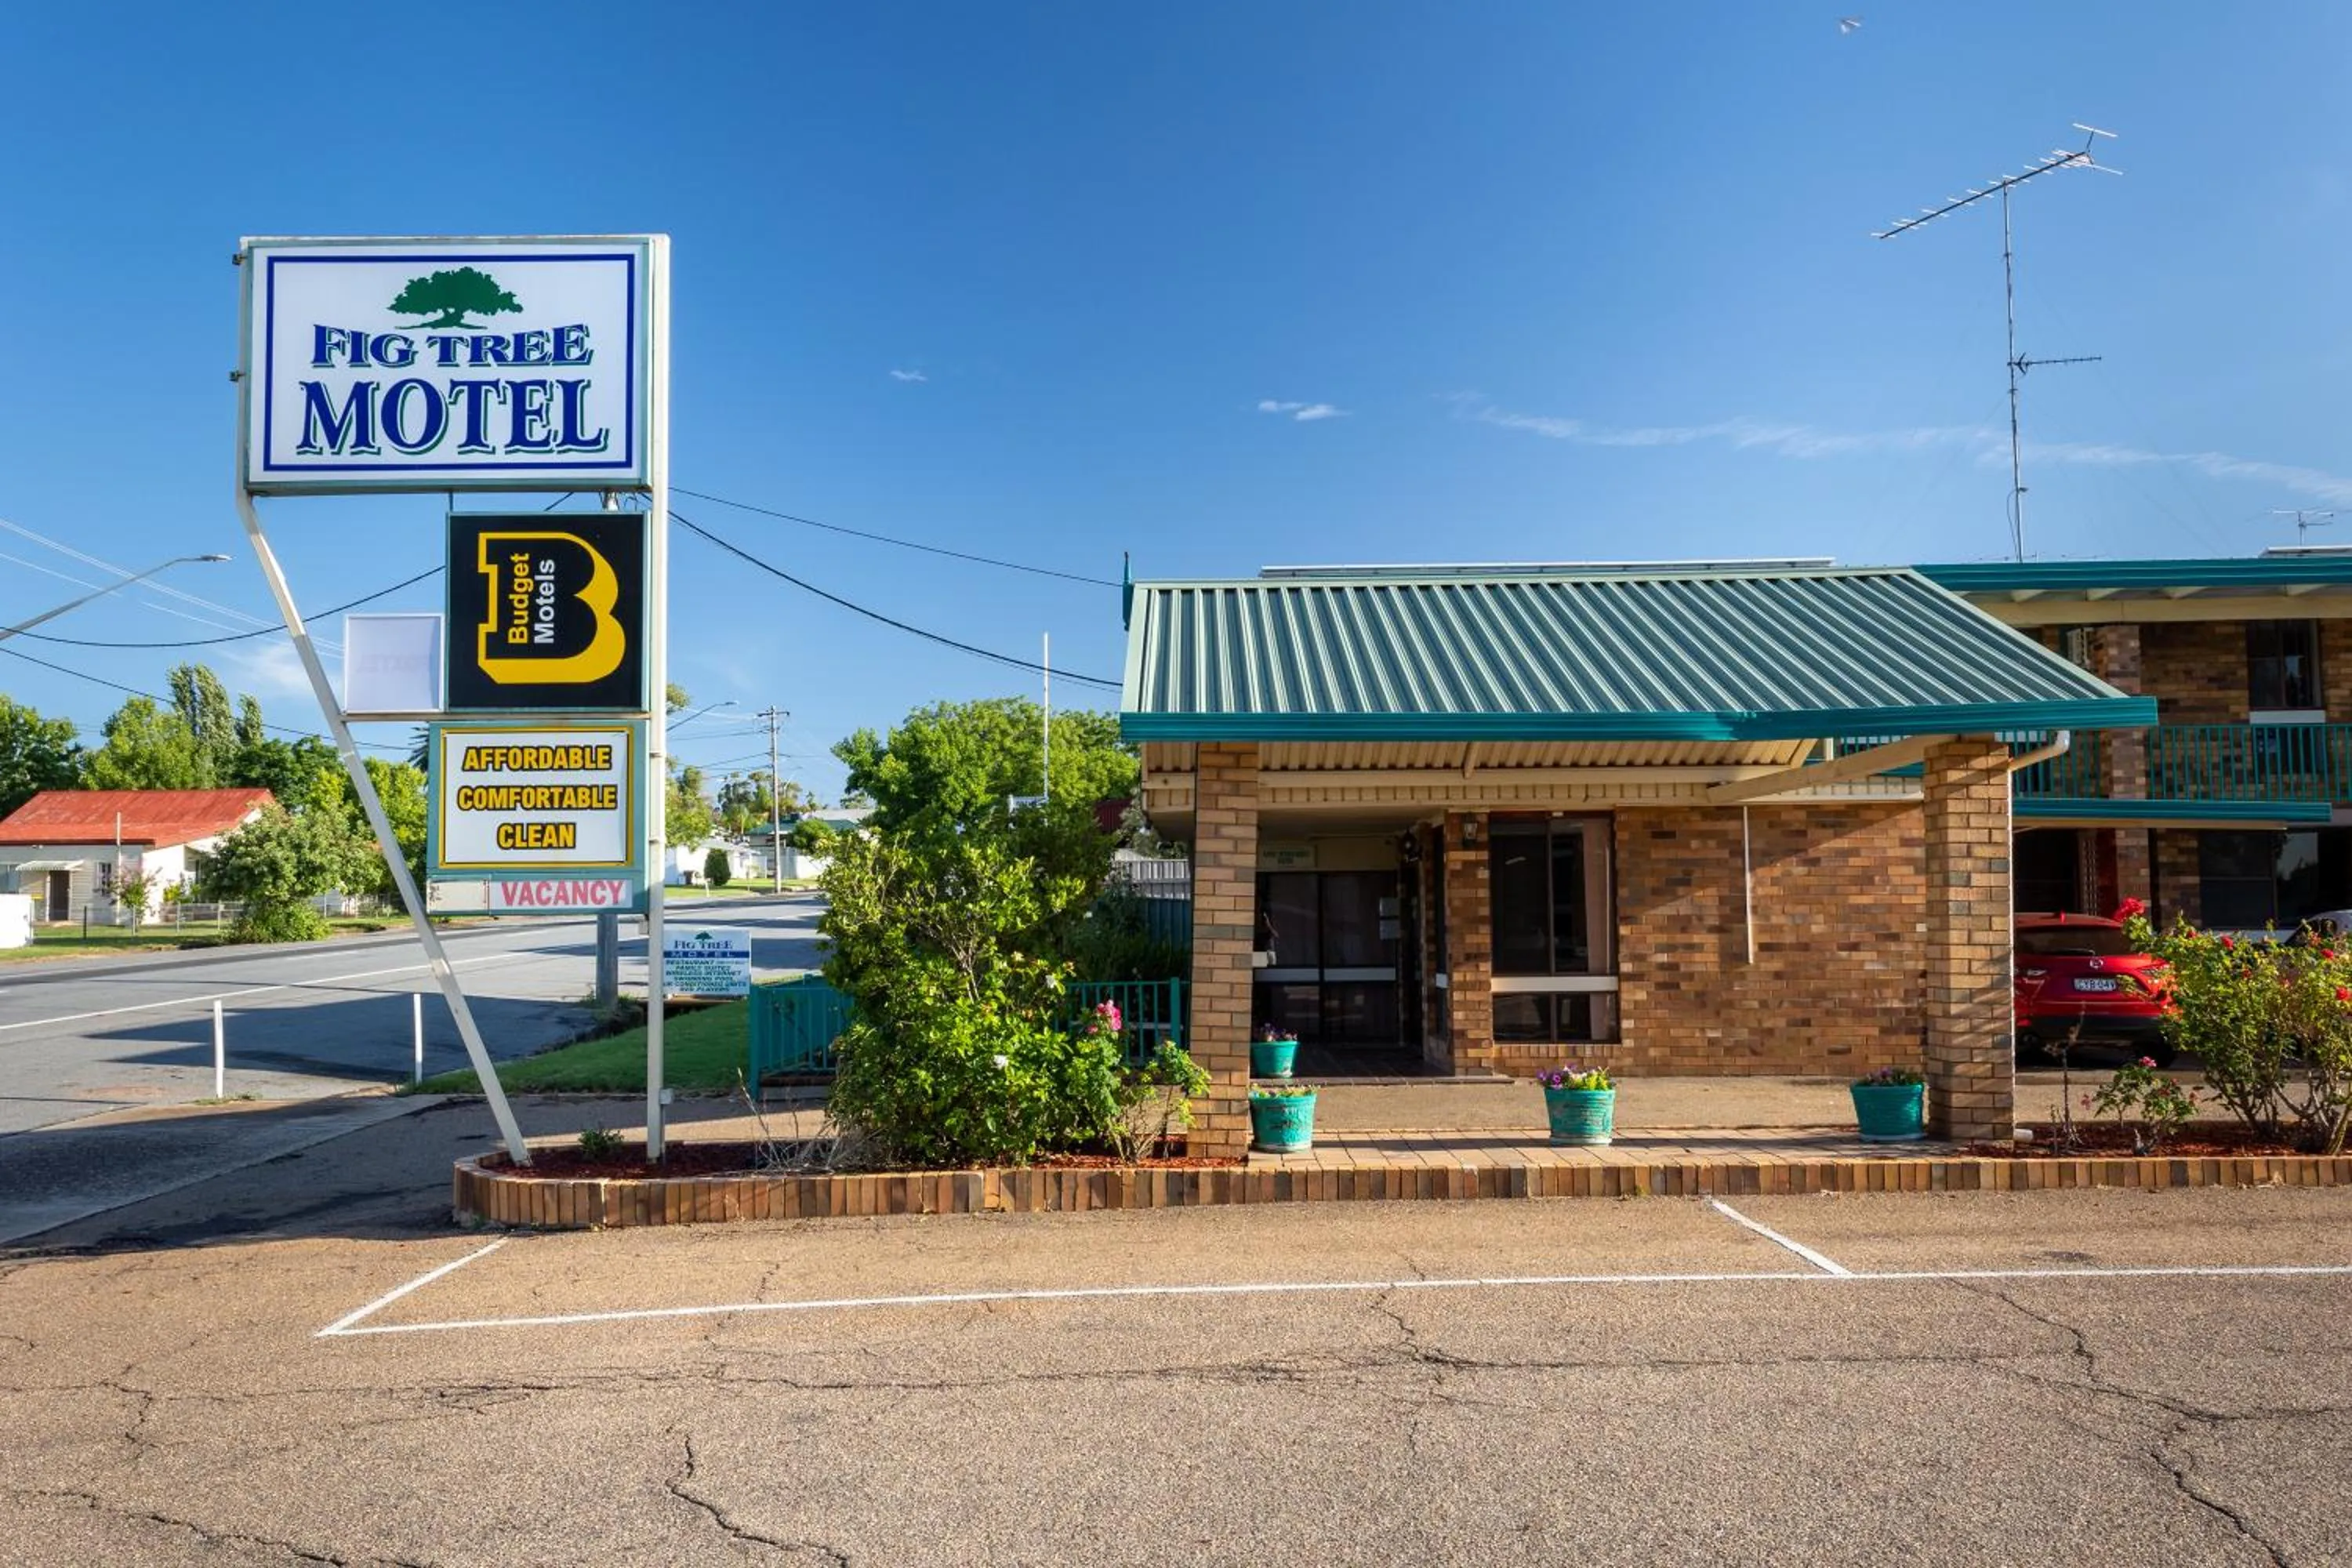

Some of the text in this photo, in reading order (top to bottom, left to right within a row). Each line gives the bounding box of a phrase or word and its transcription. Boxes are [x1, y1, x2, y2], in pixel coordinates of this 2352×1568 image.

[310, 324, 594, 368] FIG TREE
[296, 378, 610, 456] MOTEL
[508, 553, 534, 644] Budget
[534, 558, 555, 644] Motels
[462, 746, 612, 771] AFFORDABLE
[457, 784, 618, 811] COMFORTABLE
[496, 822, 576, 850] CLEAN
[500, 880, 626, 906] VACANCY
[674, 940, 733, 949] FIG TREE
